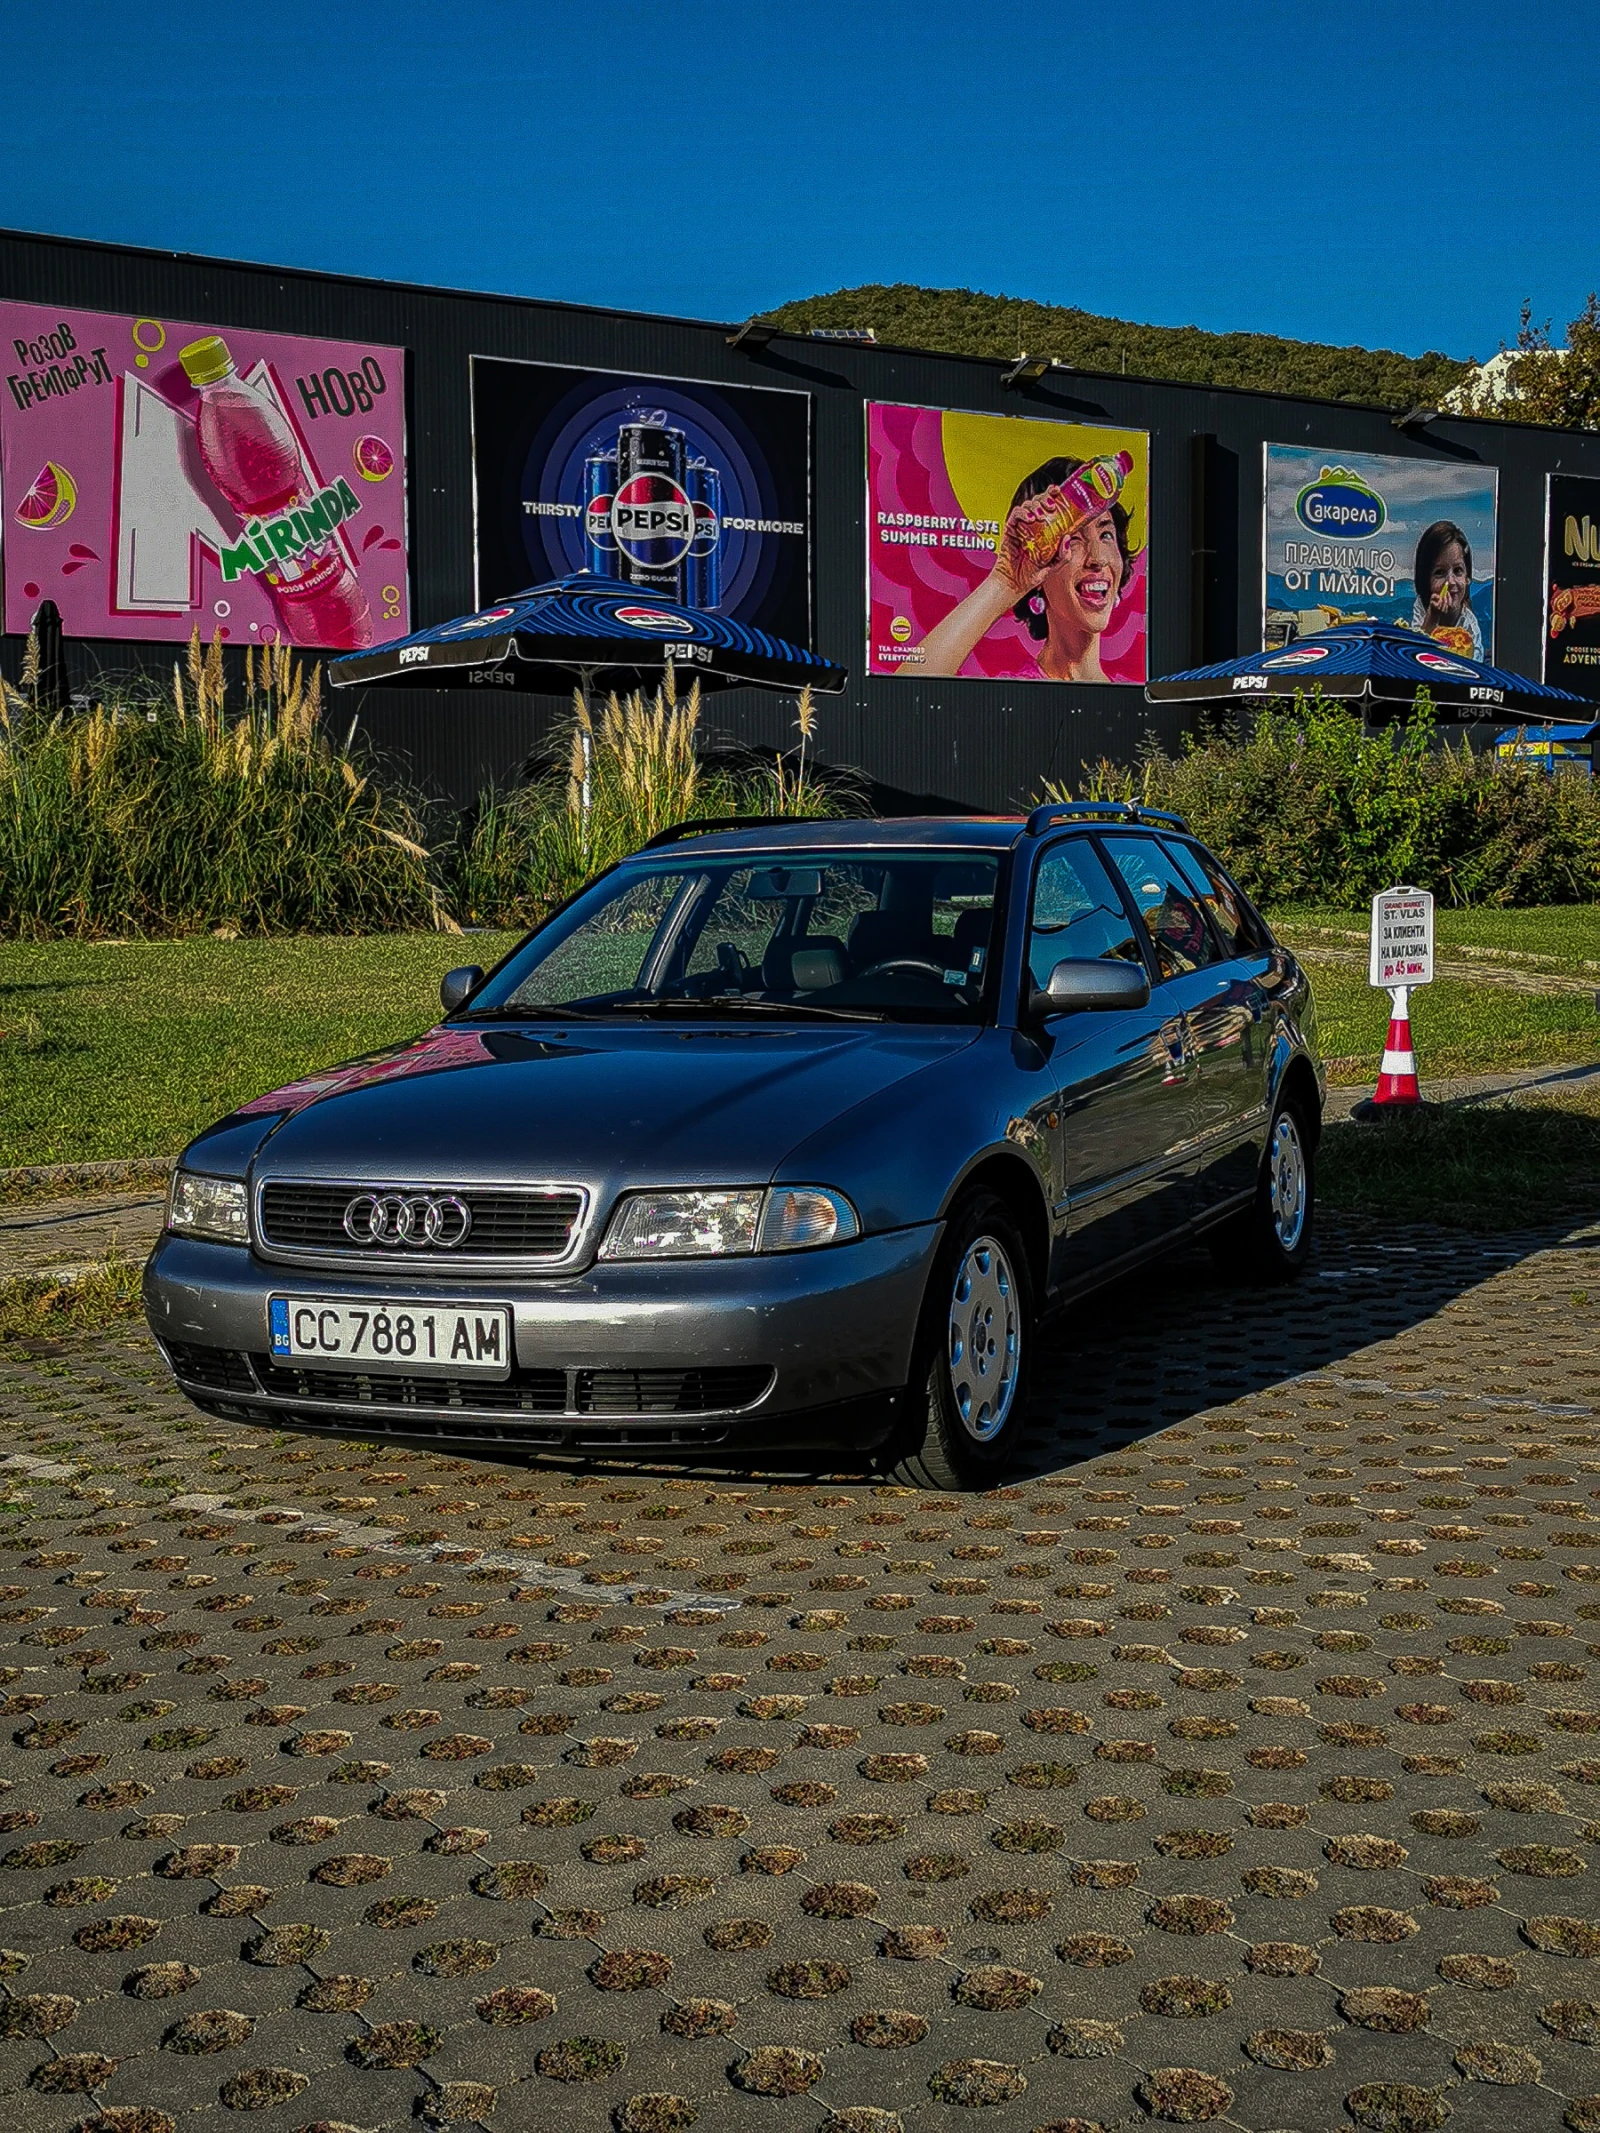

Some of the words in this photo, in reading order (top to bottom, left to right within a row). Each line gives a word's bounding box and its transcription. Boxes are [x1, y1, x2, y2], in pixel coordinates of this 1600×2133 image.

[296, 355, 387, 419] НОВО
[522, 501, 582, 517] THIRSTY
[1305, 493, 1377, 525] Сакарела
[617, 509, 690, 533] PEPSI
[722, 517, 756, 530] FOR
[759, 520, 804, 534] MORE
[877, 512, 957, 531] RASPBERRY
[960, 519, 1000, 534] TASTE
[880, 530, 938, 547] SUMMER
[941, 534, 996, 550] FEELING
[1285, 543, 1366, 569] ПРАВИМ
[1370, 550, 1395, 571] ГО
[1285, 569, 1312, 591] ОТ
[1318, 573, 1395, 597] МЛЯКО!
[399, 647, 430, 664] PEPSI
[663, 643, 713, 663] PEPSI
[1232, 676, 1268, 689] PEPSI
[1469, 687, 1504, 703] PEPSI
[1384, 910, 1398, 920] ST.
[1400, 908, 1425, 919] VLAS
[1384, 927, 1392, 939] ЗА
[1394, 925, 1425, 939] КЛИЕНТИ
[1381, 946, 1390, 959] НА
[1395, 960, 1405, 975] 45
[275, 1334, 289, 1347] BG
